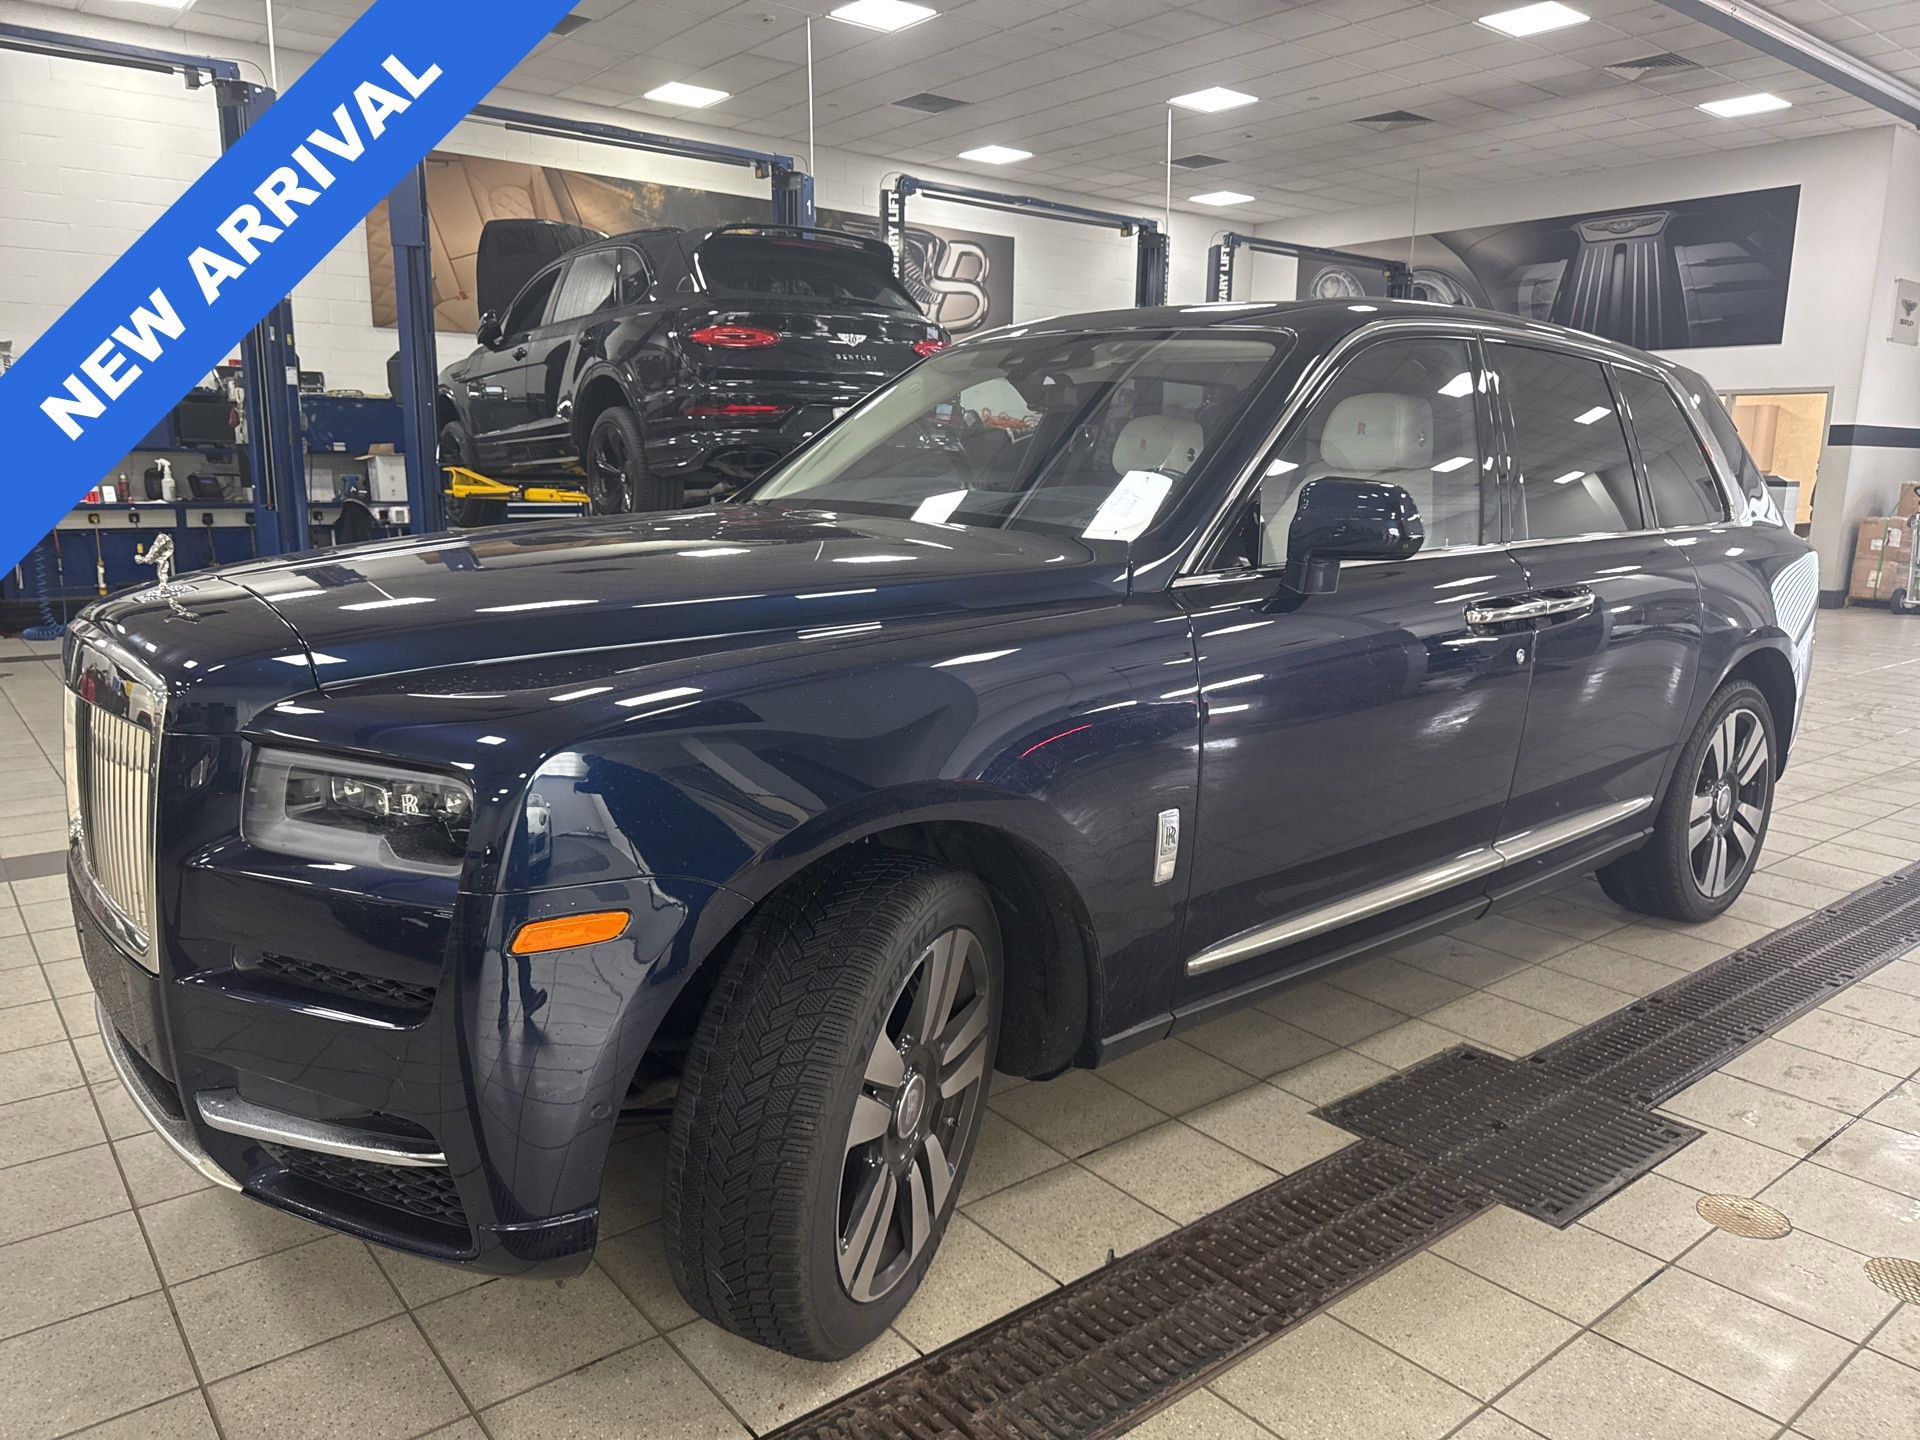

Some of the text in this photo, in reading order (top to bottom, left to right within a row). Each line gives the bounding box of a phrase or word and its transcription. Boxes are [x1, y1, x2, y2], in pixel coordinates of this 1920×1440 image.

[806, 199, 812, 215] 1
[887, 190, 899, 222] LIFT
[1222, 245, 1231, 271] LIFT
[835, 353, 877, 362] BENTLEY
